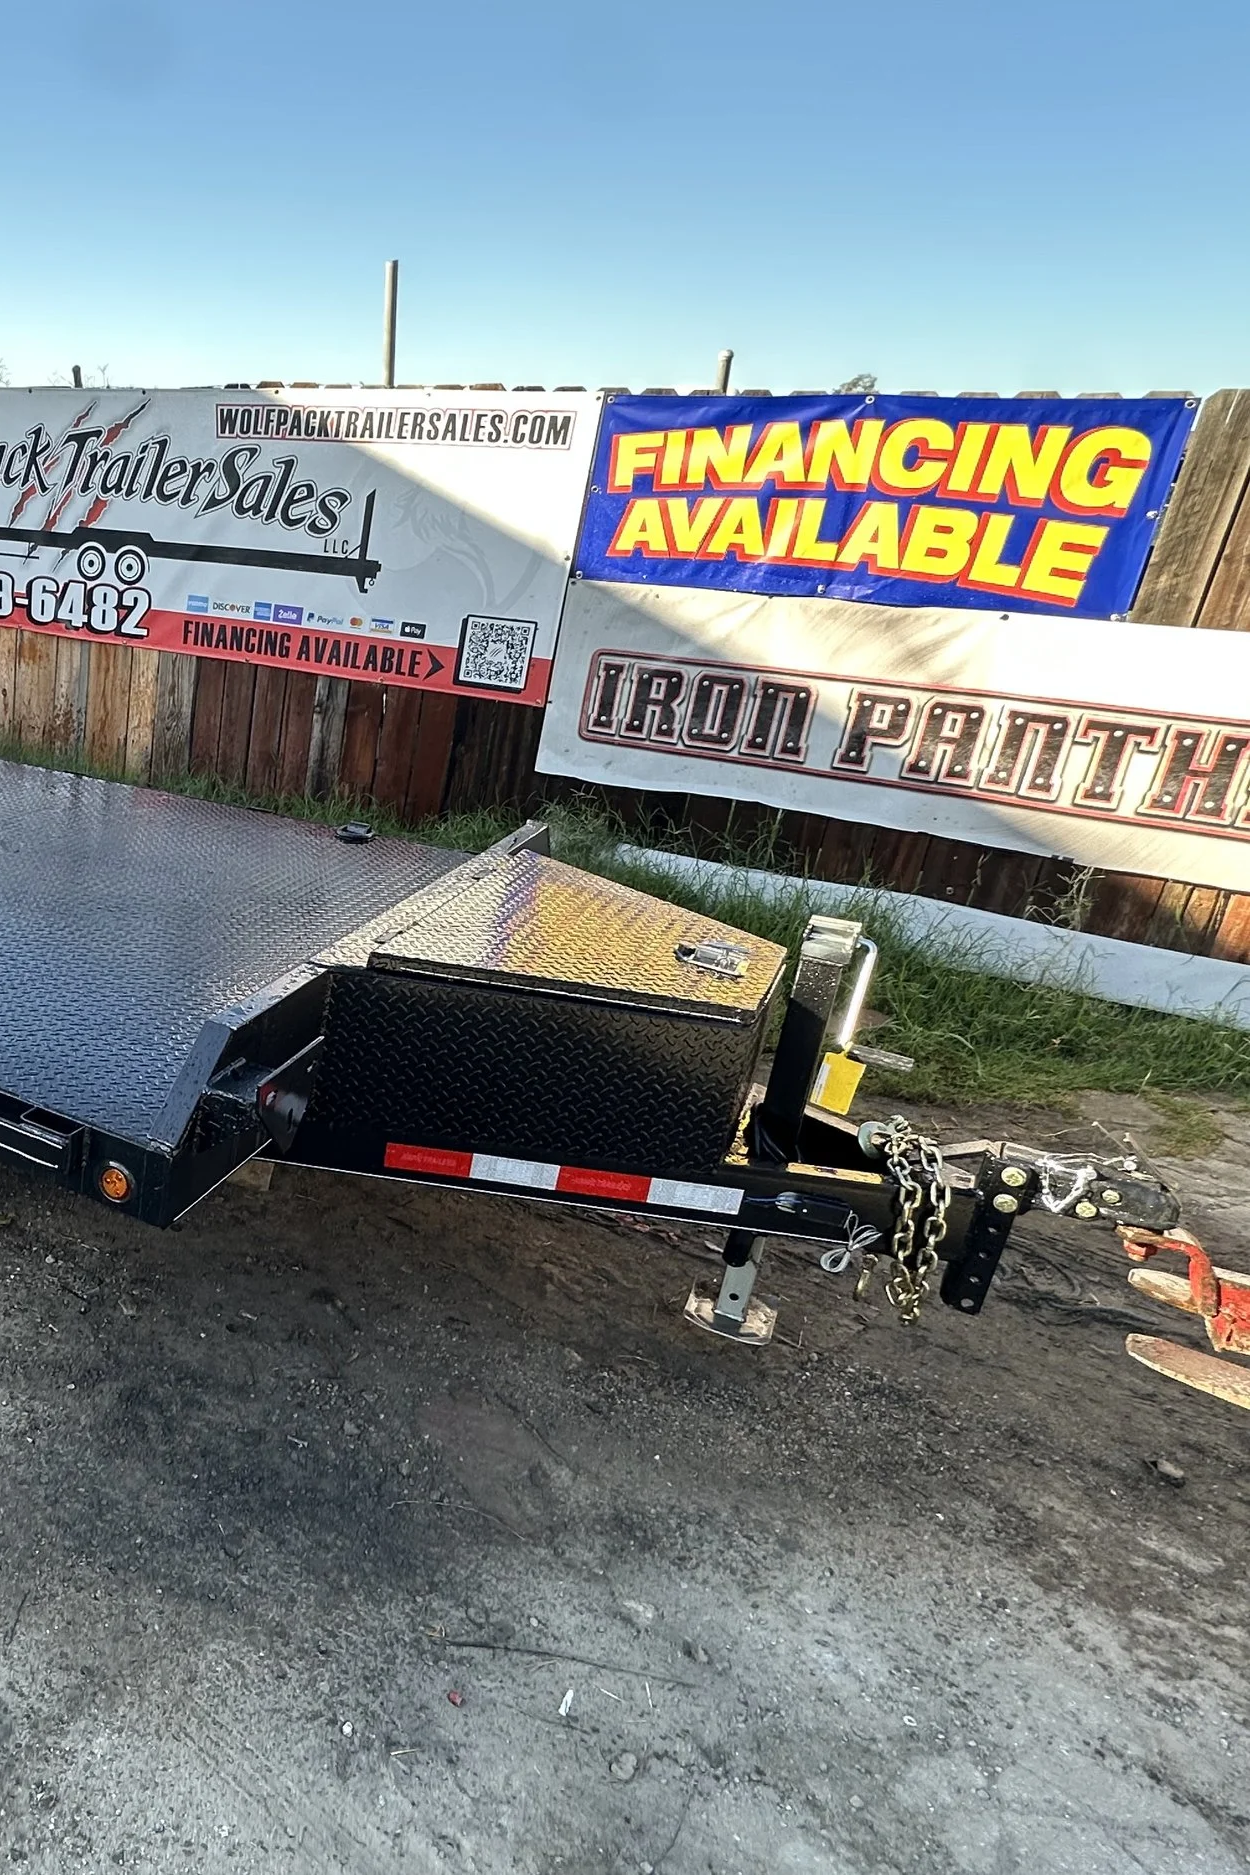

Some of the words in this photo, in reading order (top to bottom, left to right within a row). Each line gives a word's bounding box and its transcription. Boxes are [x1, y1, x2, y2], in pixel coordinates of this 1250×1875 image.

[218, 407, 573, 446] WOLFPACKTRAILERSALES.COM
[607, 417, 1153, 517] FINANCING
[323, 538, 349, 555] LLC
[605, 497, 1110, 607] AVAILABLE
[212, 601, 251, 614] DISCOVER
[316, 614, 345, 626] PayPal
[373, 622, 390, 631] VISA
[182, 619, 292, 659] FINANCING
[296, 634, 424, 679] AVAILABLE
[588, 658, 818, 764] IRON
[833, 688, 1250, 829] PANTH
